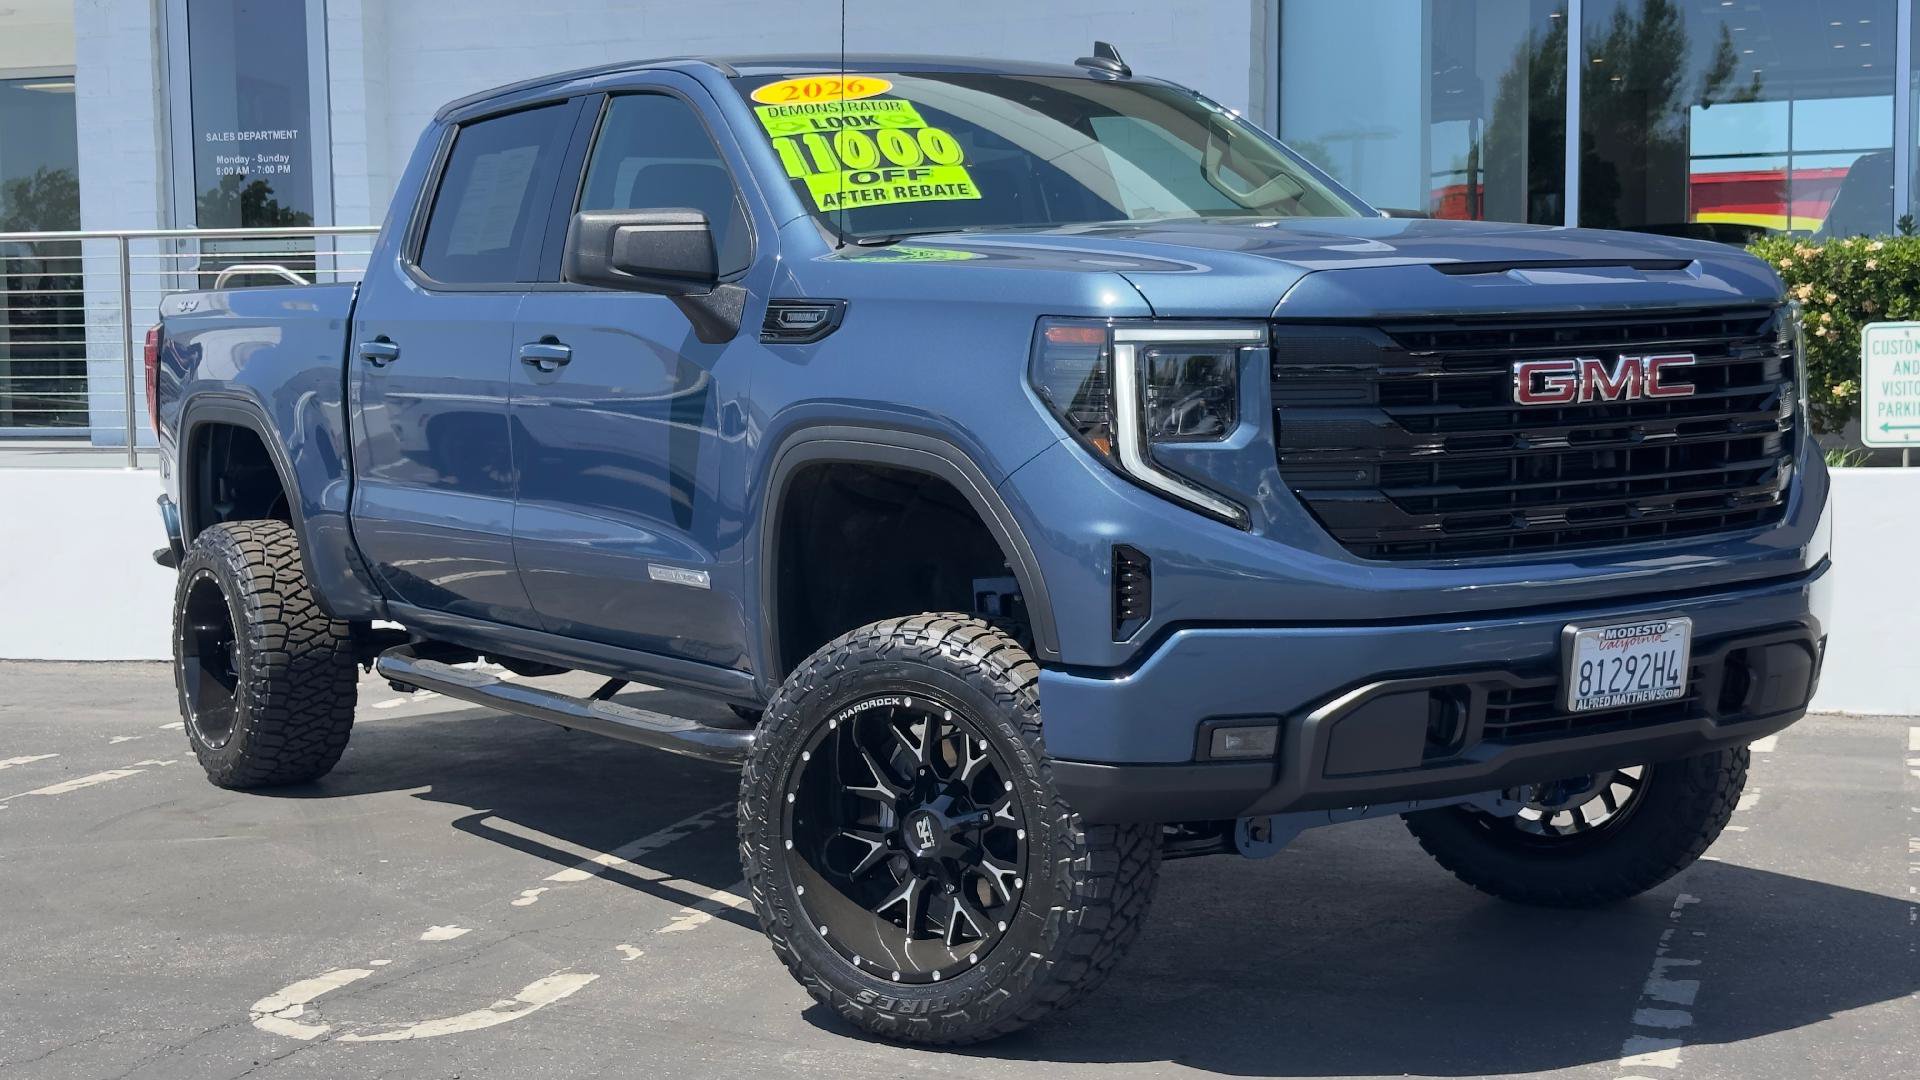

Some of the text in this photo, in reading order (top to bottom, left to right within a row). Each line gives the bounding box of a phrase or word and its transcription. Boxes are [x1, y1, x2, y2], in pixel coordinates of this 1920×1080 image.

[782, 79, 865, 101] 2026
[768, 101, 902, 118] DEMONSTRATOR
[809, 115, 880, 130] LOOK
[206, 130, 298, 142] SALES DEPARTMENT
[216, 155, 250, 165] Monday
[257, 154, 290, 164] Sunday
[772, 127, 964, 178] 11000
[236, 166, 250, 175] AM
[257, 165, 275, 174] 7:00
[277, 164, 291, 174] PM
[849, 168, 931, 185] OFF
[823, 183, 969, 208] AFTER REBATE
[1893, 360, 1920, 376] AND
[1513, 353, 1696, 405] GMC
[1878, 401, 1920, 417] PARKI
[1605, 623, 1666, 640] MODESTO
[1578, 649, 1679, 697] 81292H4
[839, 697, 900, 721] HARDROCK
